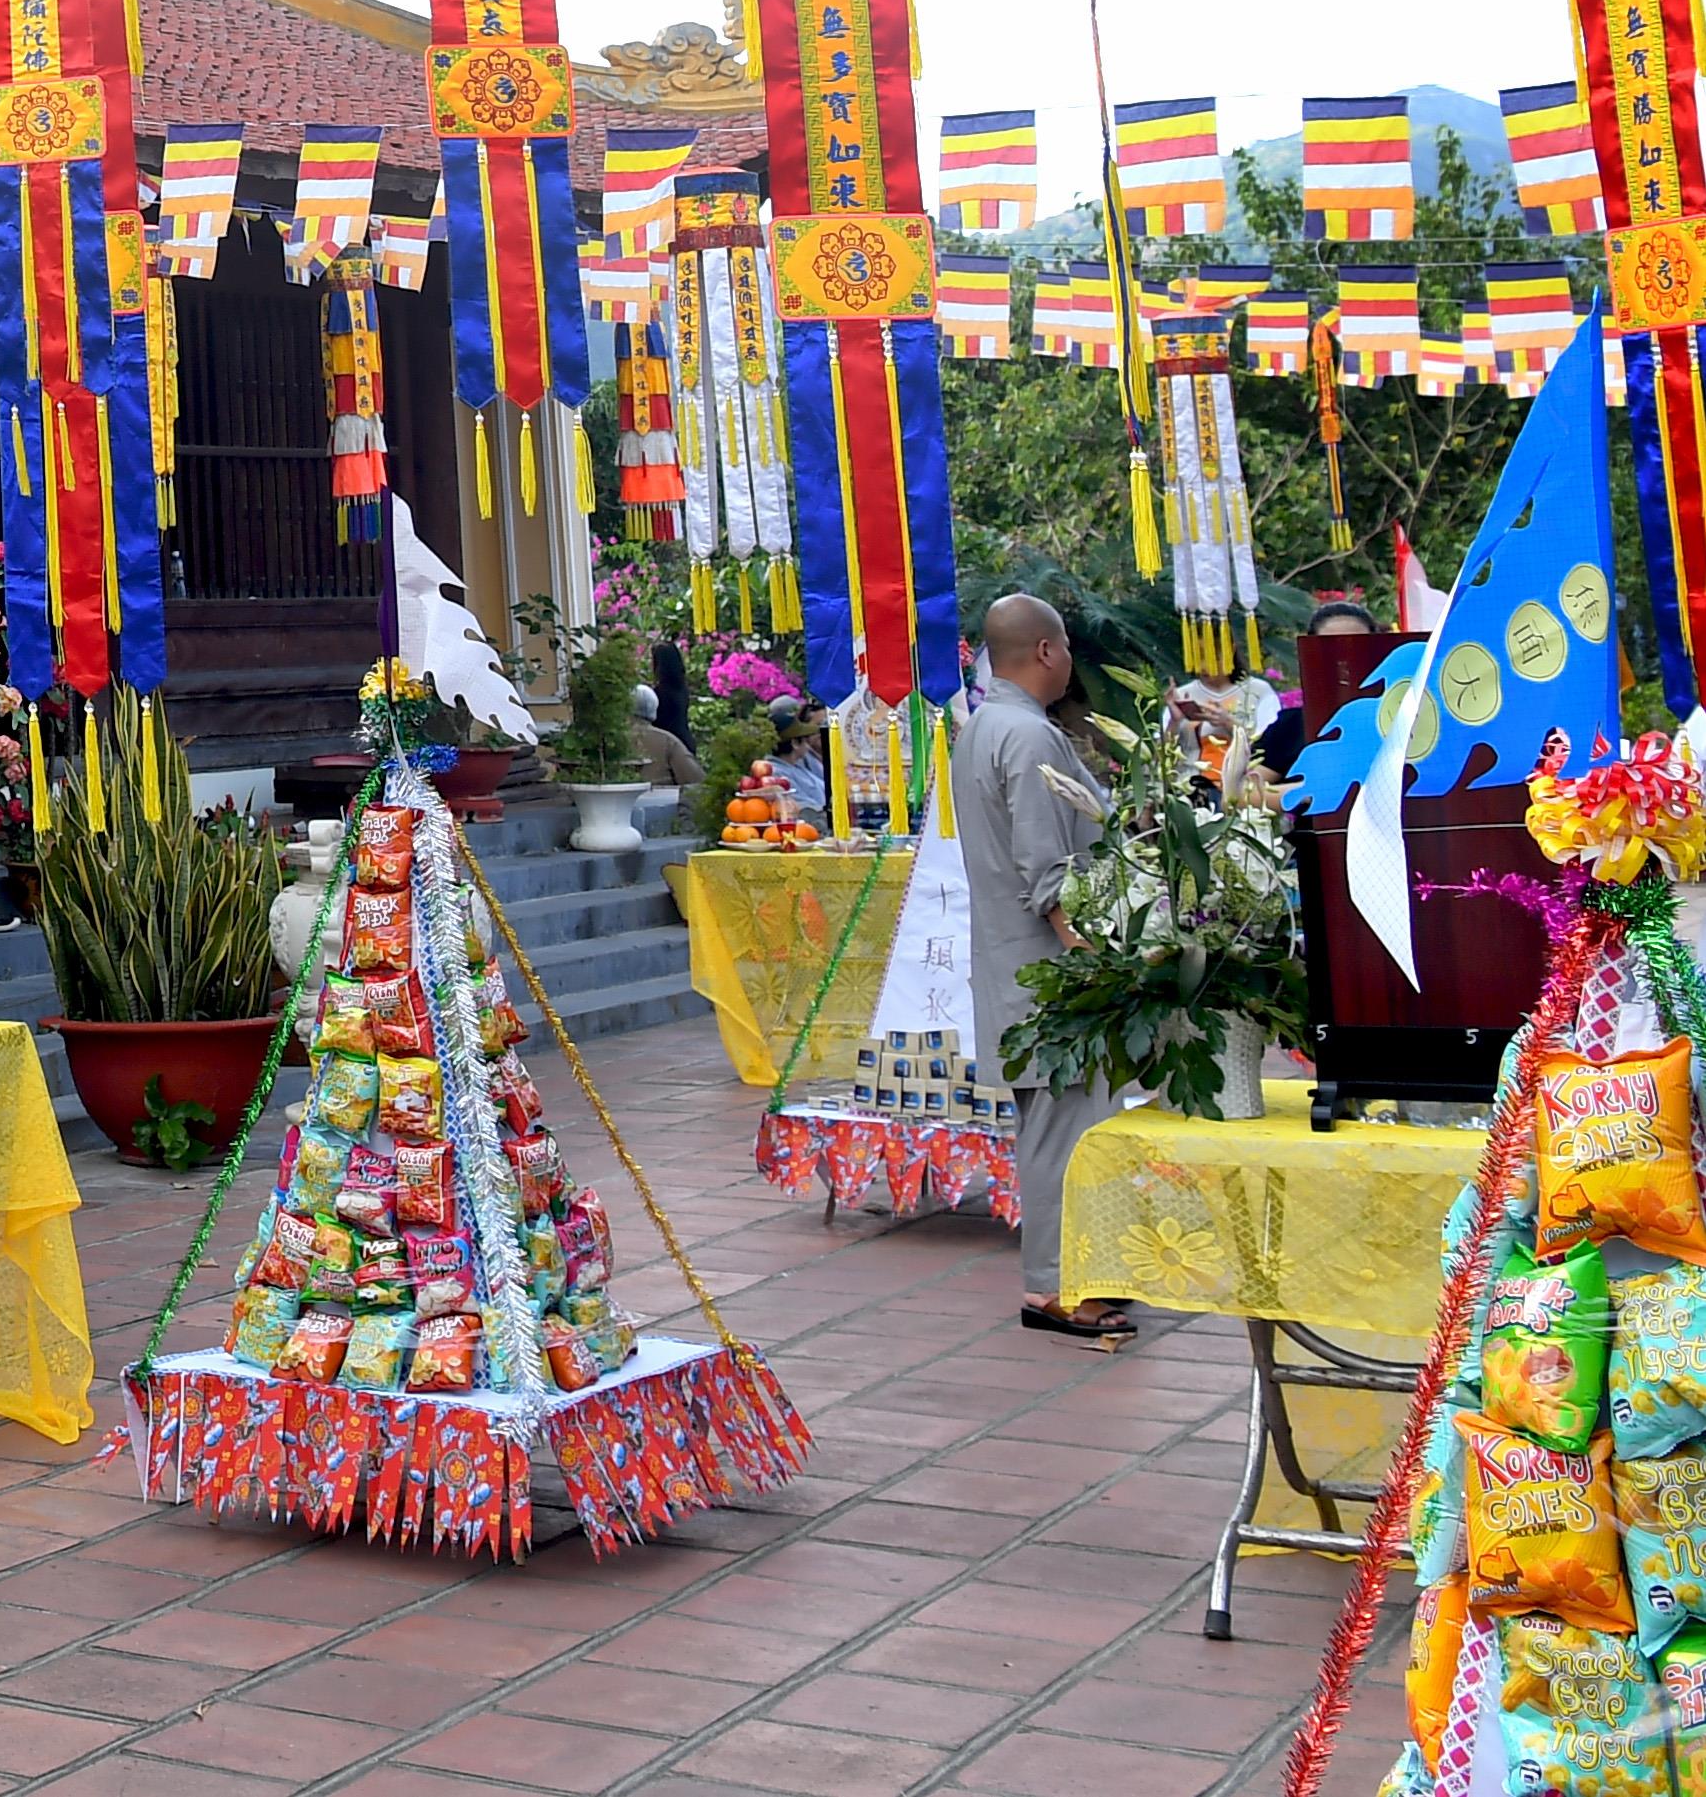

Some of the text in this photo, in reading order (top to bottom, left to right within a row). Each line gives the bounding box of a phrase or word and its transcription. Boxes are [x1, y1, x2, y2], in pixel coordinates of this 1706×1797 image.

[360, 815, 399, 832] Snack
[354, 897, 400, 913] Snack
[368, 984, 398, 1000] Oishi
[1316, 1024, 1480, 1046] 5 5
[1541, 1071, 1660, 1133] KORNY
[398, 1151, 432, 1165] Oishi
[1549, 1115, 1664, 1172] CONES
[280, 1219, 315, 1244] Oishi
[1609, 1272, 1706, 1308] Snack
[1623, 1334, 1706, 1384] Ngọt
[1470, 1433, 1594, 1492] KORNY
[1480, 1482, 1597, 1533] CONES
[1520, 1618, 1562, 1633] Oishi
[1526, 1634, 1645, 1683] Snack
[1552, 1717, 1644, 1771] Ngọt
